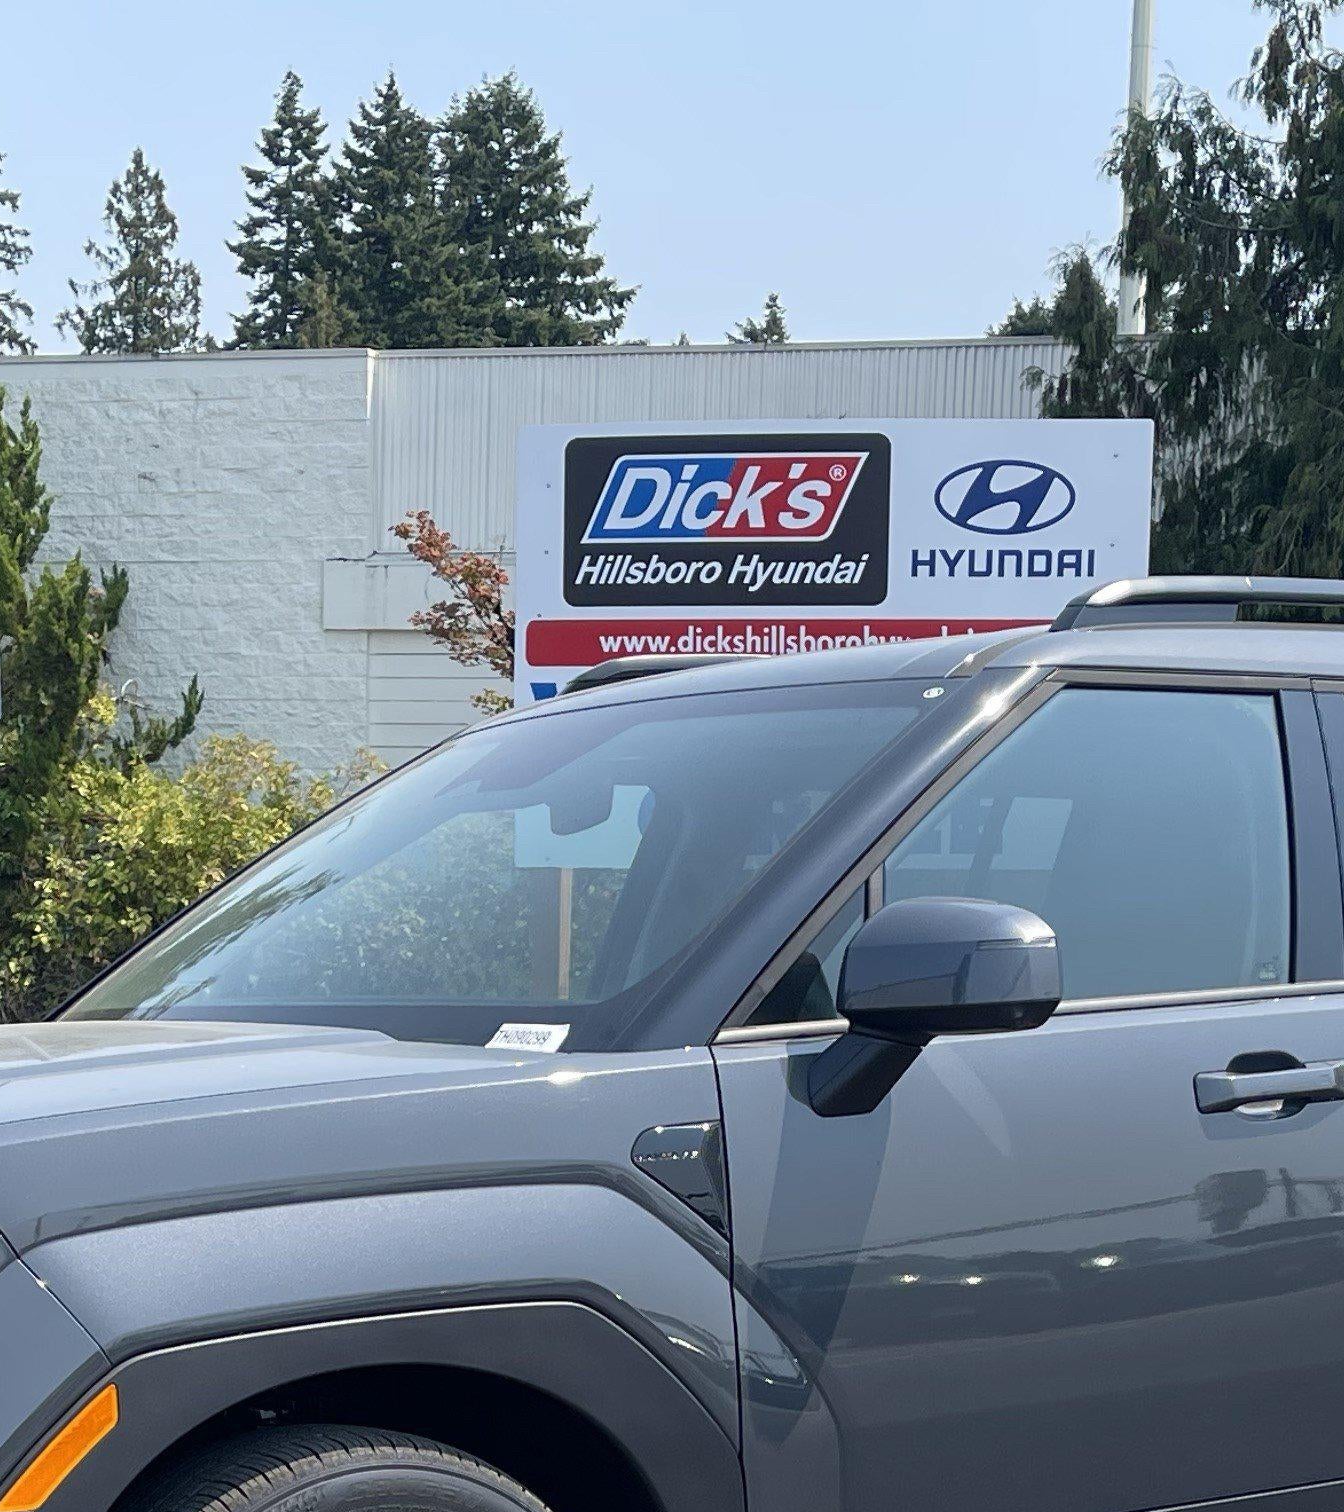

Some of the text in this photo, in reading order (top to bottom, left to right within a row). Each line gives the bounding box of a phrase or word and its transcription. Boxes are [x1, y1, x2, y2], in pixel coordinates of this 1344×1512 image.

[575, 553, 870, 592] Hillsboro Hyundai
[910, 548, 1096, 578] HYUNDAI
